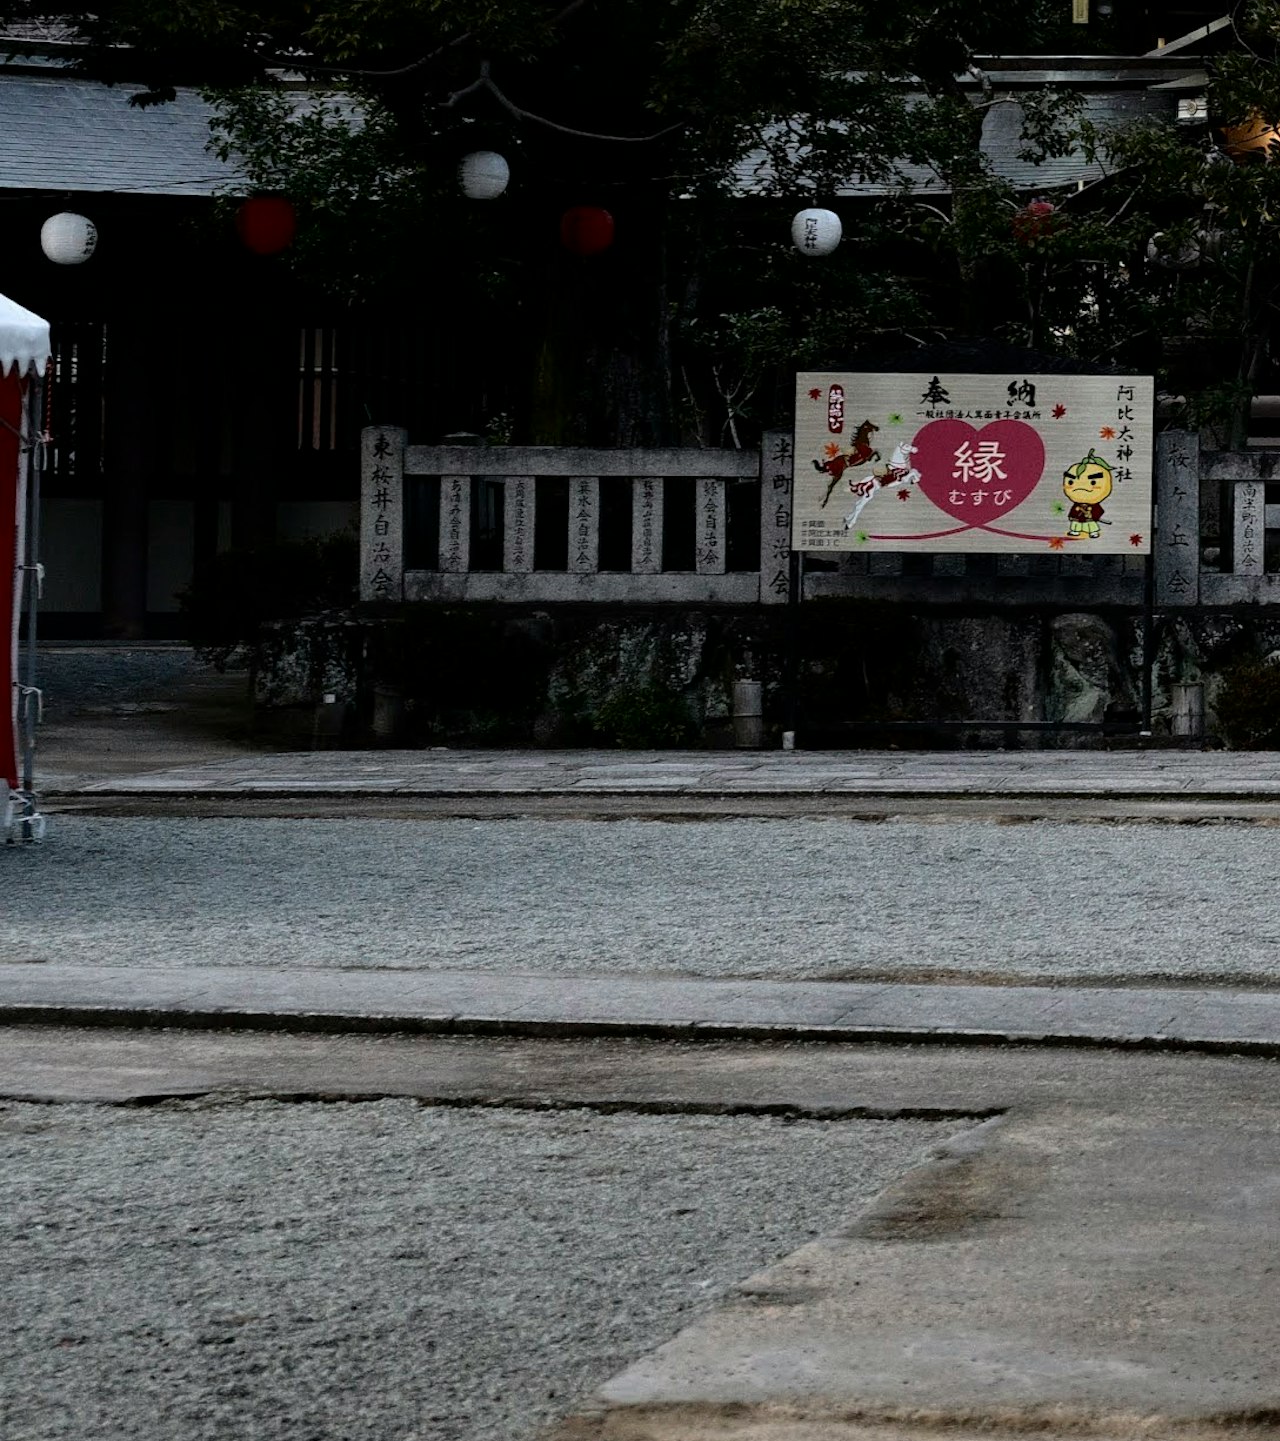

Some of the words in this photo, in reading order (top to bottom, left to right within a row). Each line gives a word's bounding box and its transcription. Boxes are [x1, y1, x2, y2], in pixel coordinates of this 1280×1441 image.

[920, 375, 1036, 409] 奉納
[1116, 385, 1136, 482] 阿比太神社
[951, 440, 1008, 484] 縁
[370, 433, 394, 592] 東桜井自治会
[947, 488, 1013, 506] むすび
